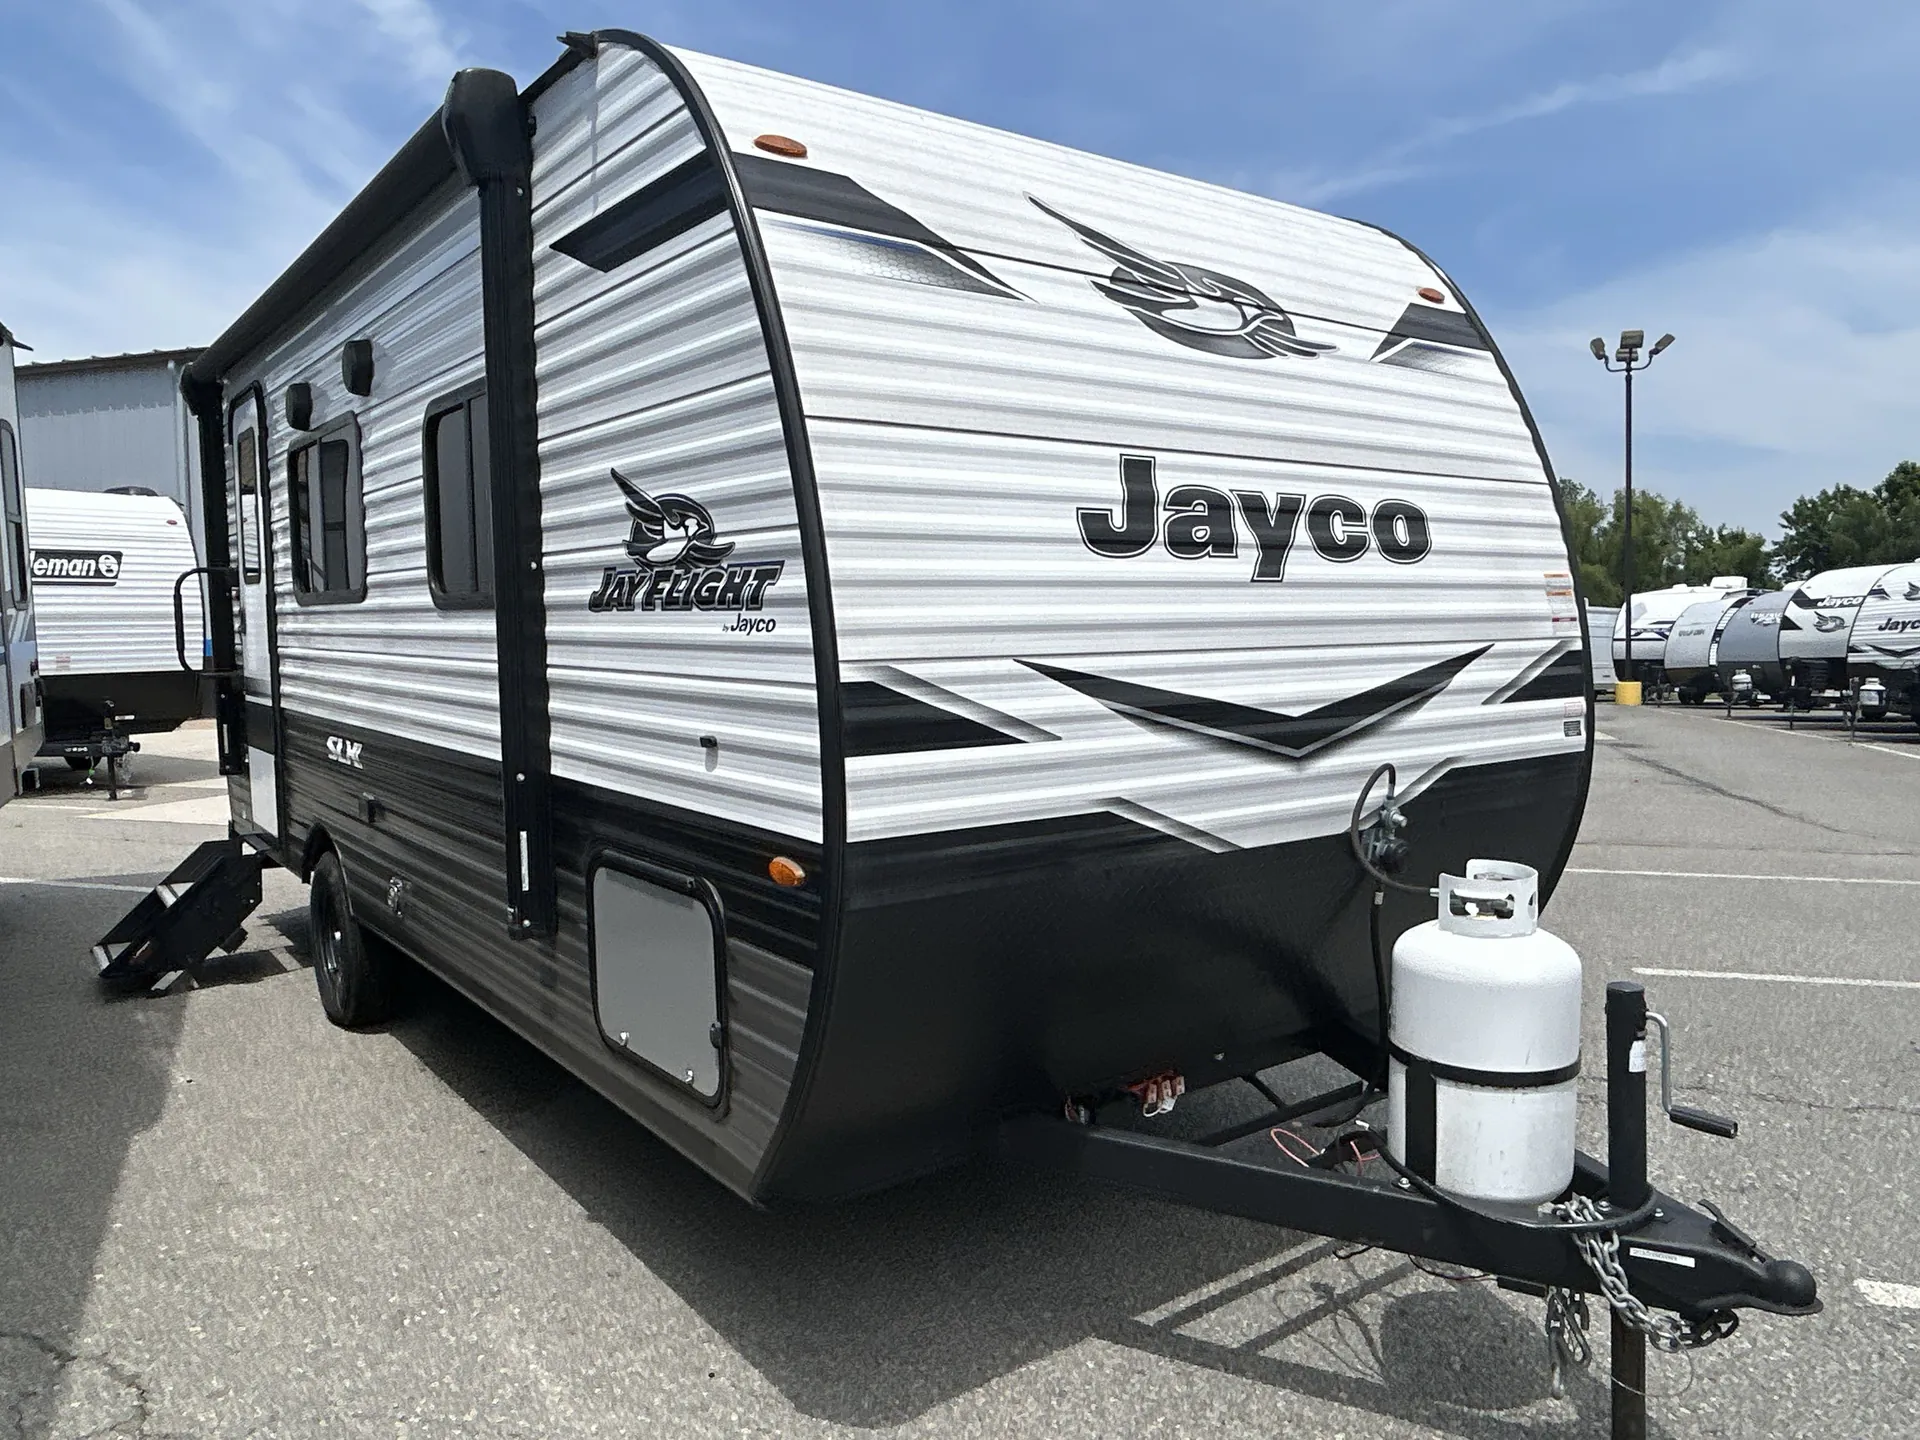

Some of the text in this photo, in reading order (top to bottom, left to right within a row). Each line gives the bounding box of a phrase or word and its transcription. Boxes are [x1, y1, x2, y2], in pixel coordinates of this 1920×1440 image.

[1076, 453, 1432, 582] Jayco
[1817, 595, 1863, 608] Jayco
[722, 612, 777, 636] by Jayco
